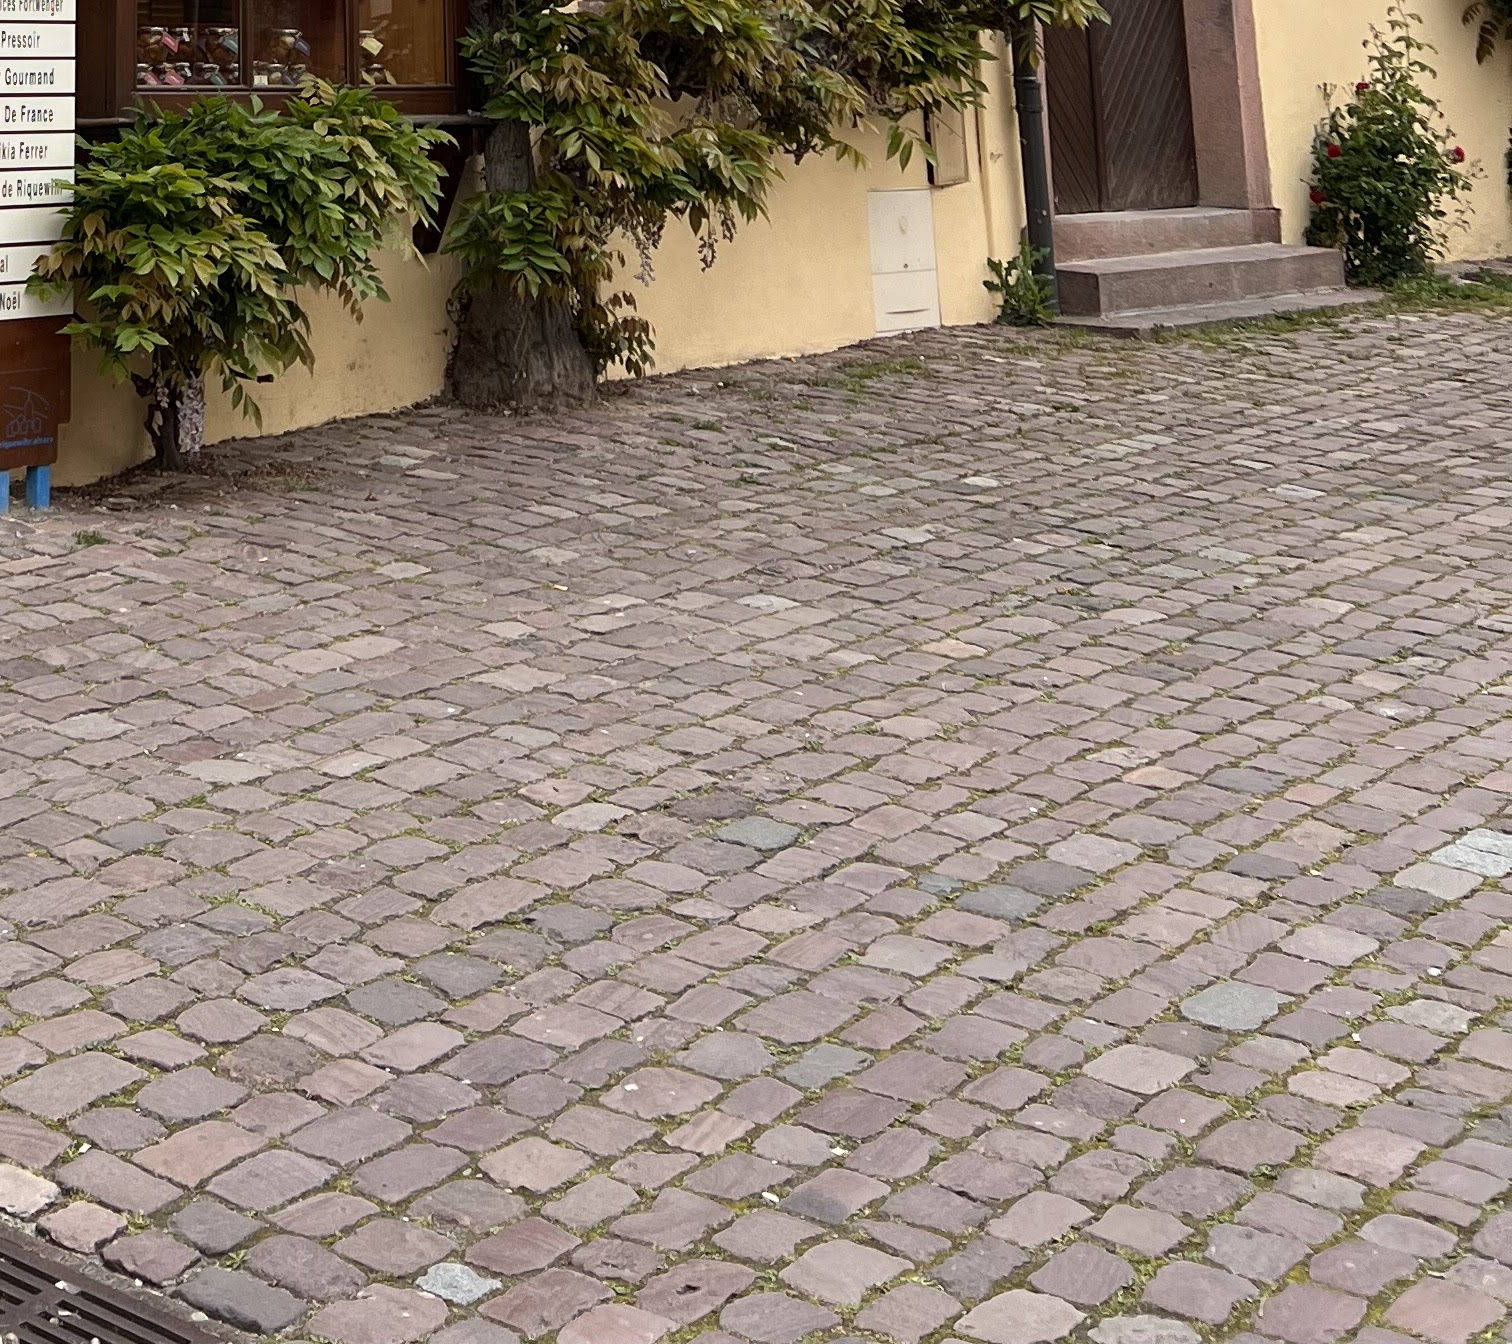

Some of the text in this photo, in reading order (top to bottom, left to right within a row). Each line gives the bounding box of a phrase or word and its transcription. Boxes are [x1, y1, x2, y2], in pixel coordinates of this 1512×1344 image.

[1, 31, 40, 48] Pressoir
[5, 68, 54, 85] Gourmand
[5, 105, 16, 123] De
[21, 105, 53, 122] France
[19, 142, 48, 159] Ferrer
[2, 180, 12, 198] de
[0, 291, 22, 312] Noël
